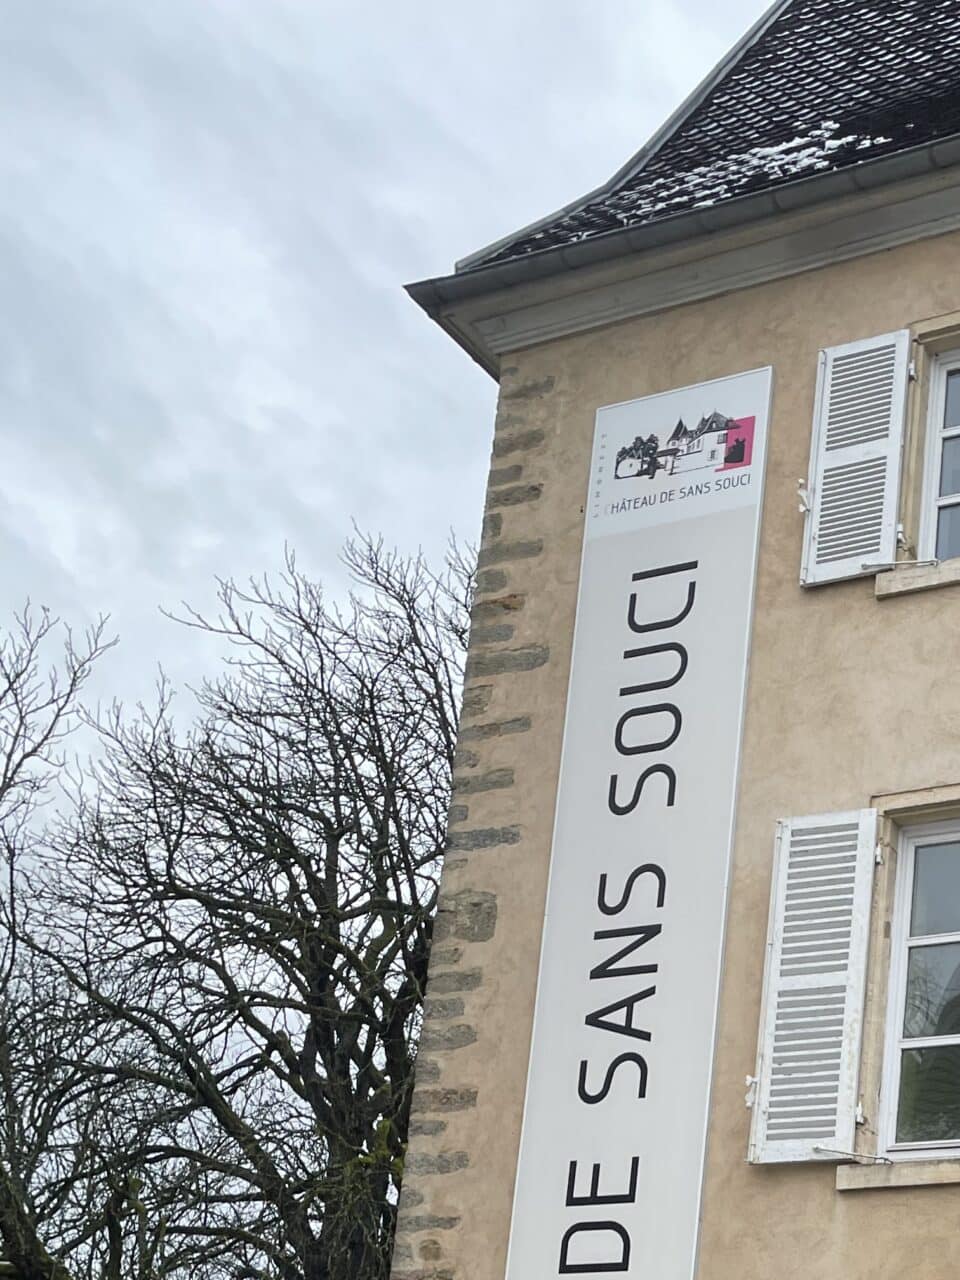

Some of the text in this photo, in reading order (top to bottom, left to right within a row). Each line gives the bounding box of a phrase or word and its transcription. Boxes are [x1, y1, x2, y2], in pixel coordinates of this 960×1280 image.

[660, 489, 674, 504] DE
[679, 481, 711, 500] SANS
[715, 473, 751, 492] SOUCI
[608, 560, 699, 816] SOUCI
[577, 863, 667, 1105] SANS
[558, 1156, 640, 1274] DE
